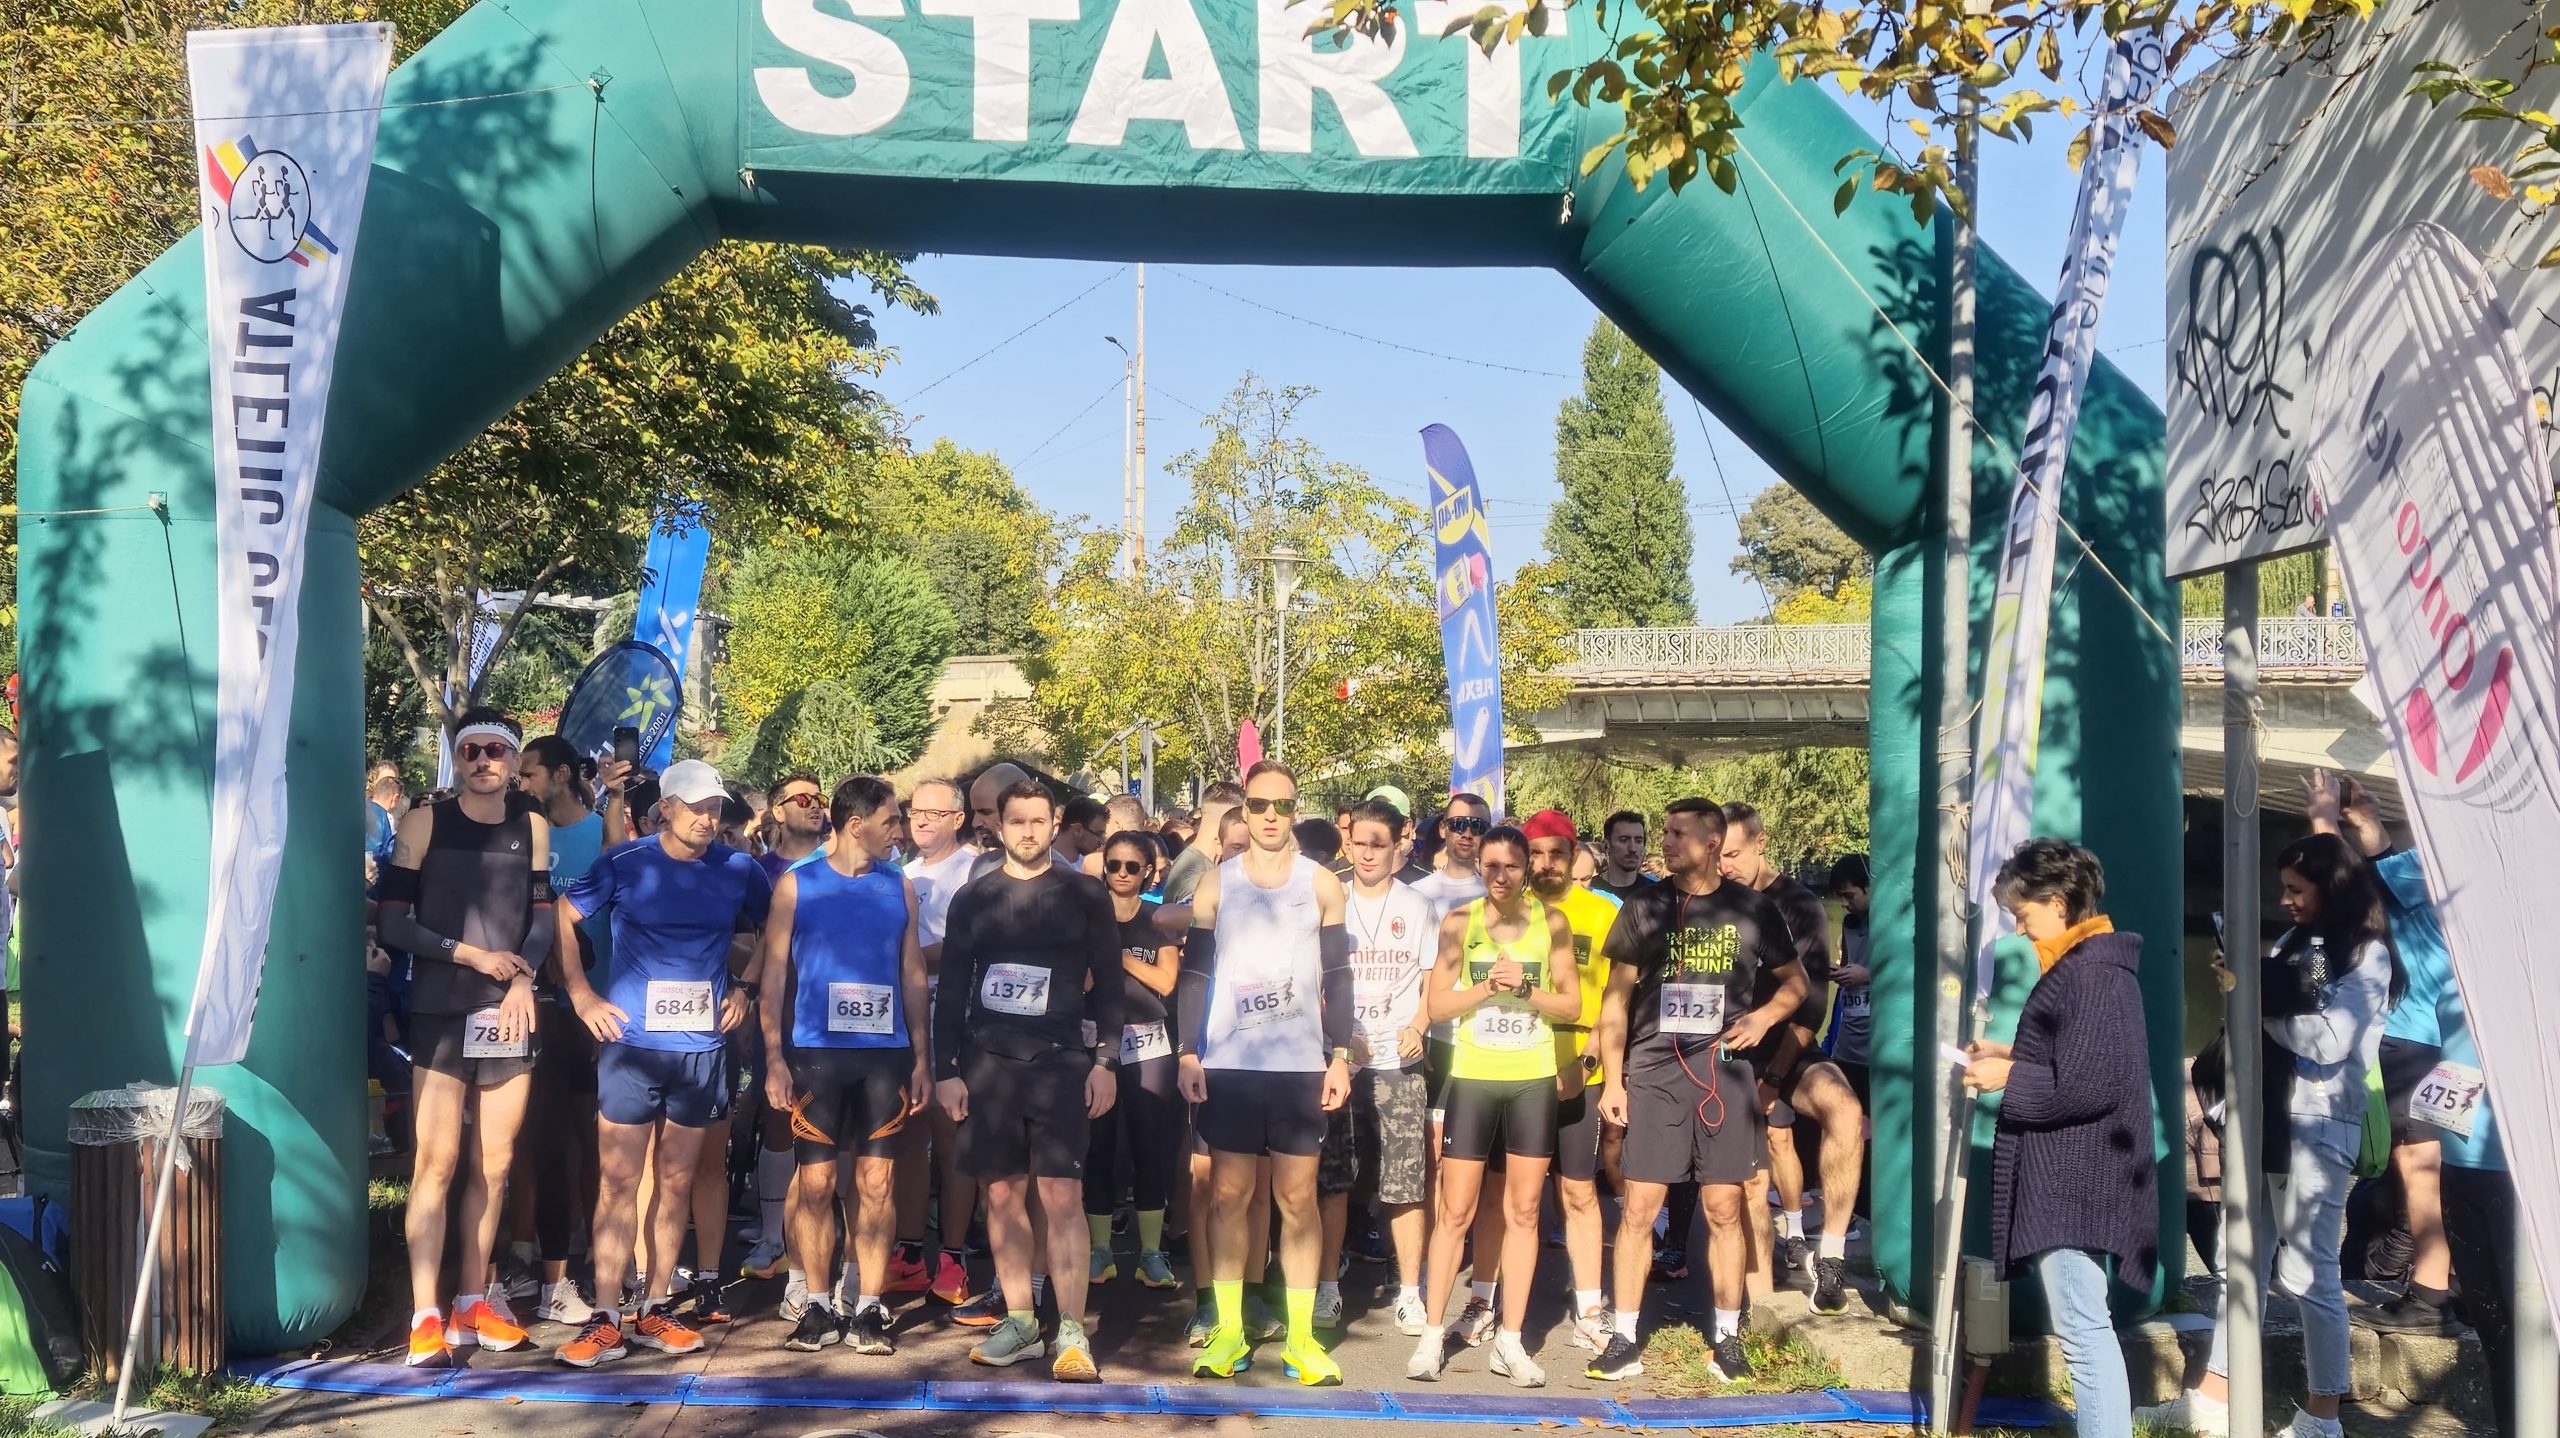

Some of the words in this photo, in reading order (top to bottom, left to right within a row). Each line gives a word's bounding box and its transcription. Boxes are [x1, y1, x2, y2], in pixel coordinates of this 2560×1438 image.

[752, 0, 1569, 159] START
[639, 734, 653, 759] ince
[649, 711, 668, 736] 2001
[1354, 946, 1412, 964] mirates
[1365, 967, 1400, 981] BETTER
[990, 981, 1029, 1000] 137
[655, 1000, 695, 1015] 684
[836, 1000, 874, 1017] 683
[1241, 992, 1280, 1014] 165
[1667, 1002, 1705, 1018] 212
[1485, 1017, 1523, 1034] 186
[1124, 1033, 1155, 1052] 157
[2420, 1083, 2459, 1110] 475
